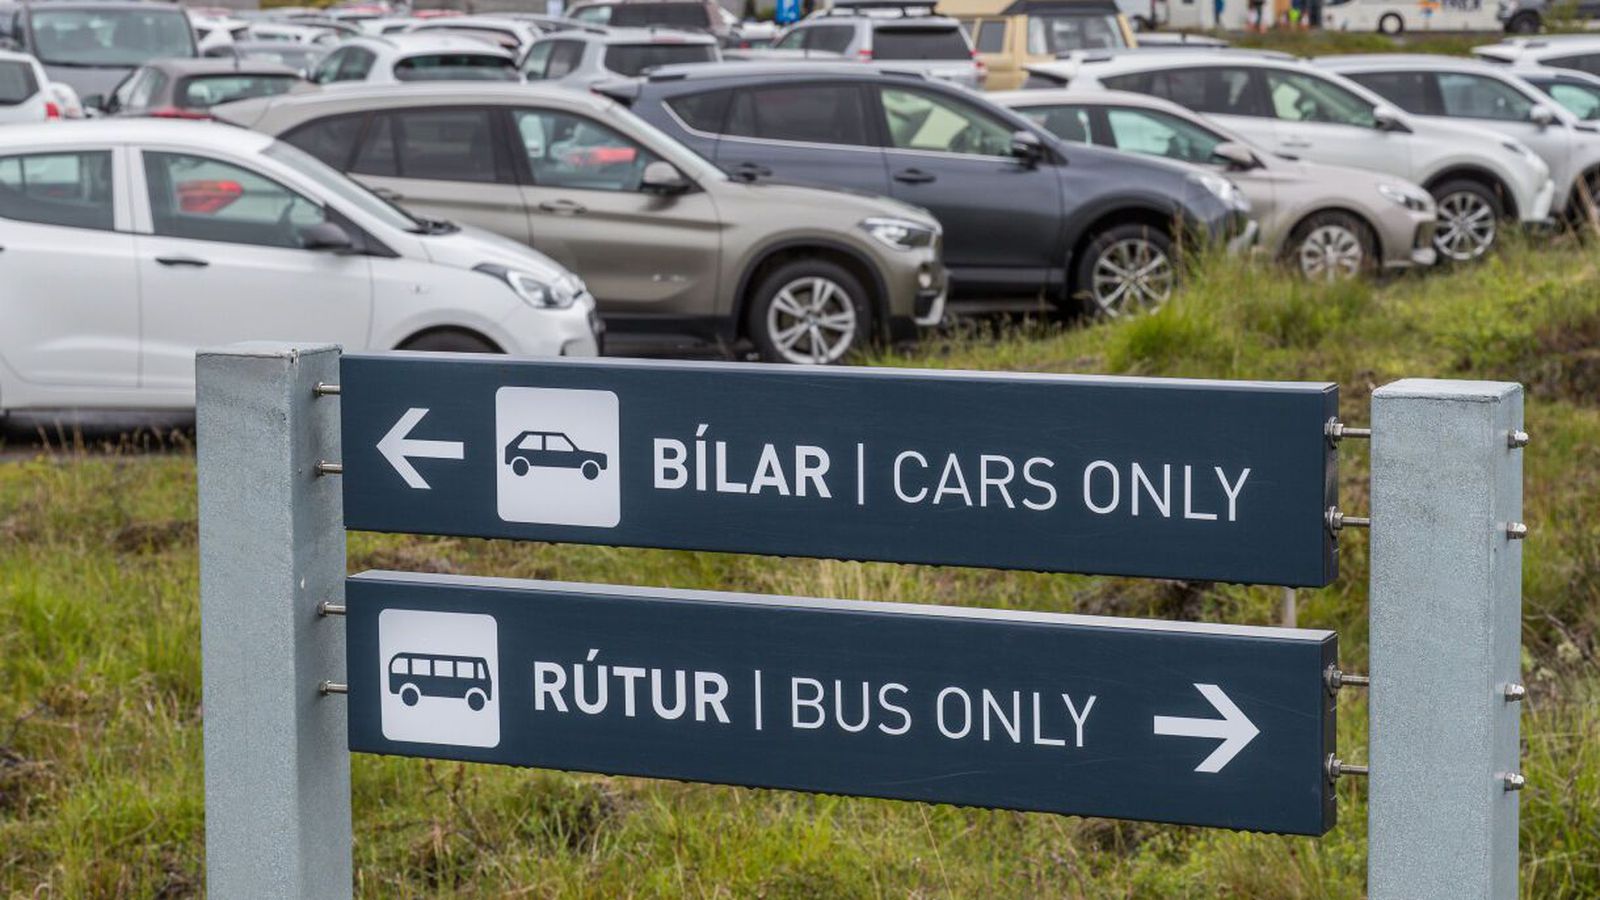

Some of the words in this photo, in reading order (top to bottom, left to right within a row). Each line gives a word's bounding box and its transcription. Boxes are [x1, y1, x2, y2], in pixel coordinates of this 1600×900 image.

[653, 423, 832, 498] BÍLAR
[893, 450, 1057, 511] CARS
[1083, 460, 1251, 522] ONLY
[534, 648, 731, 724] RÚTUR
[791, 677, 912, 735] BUS
[936, 686, 1097, 748] ONLY
